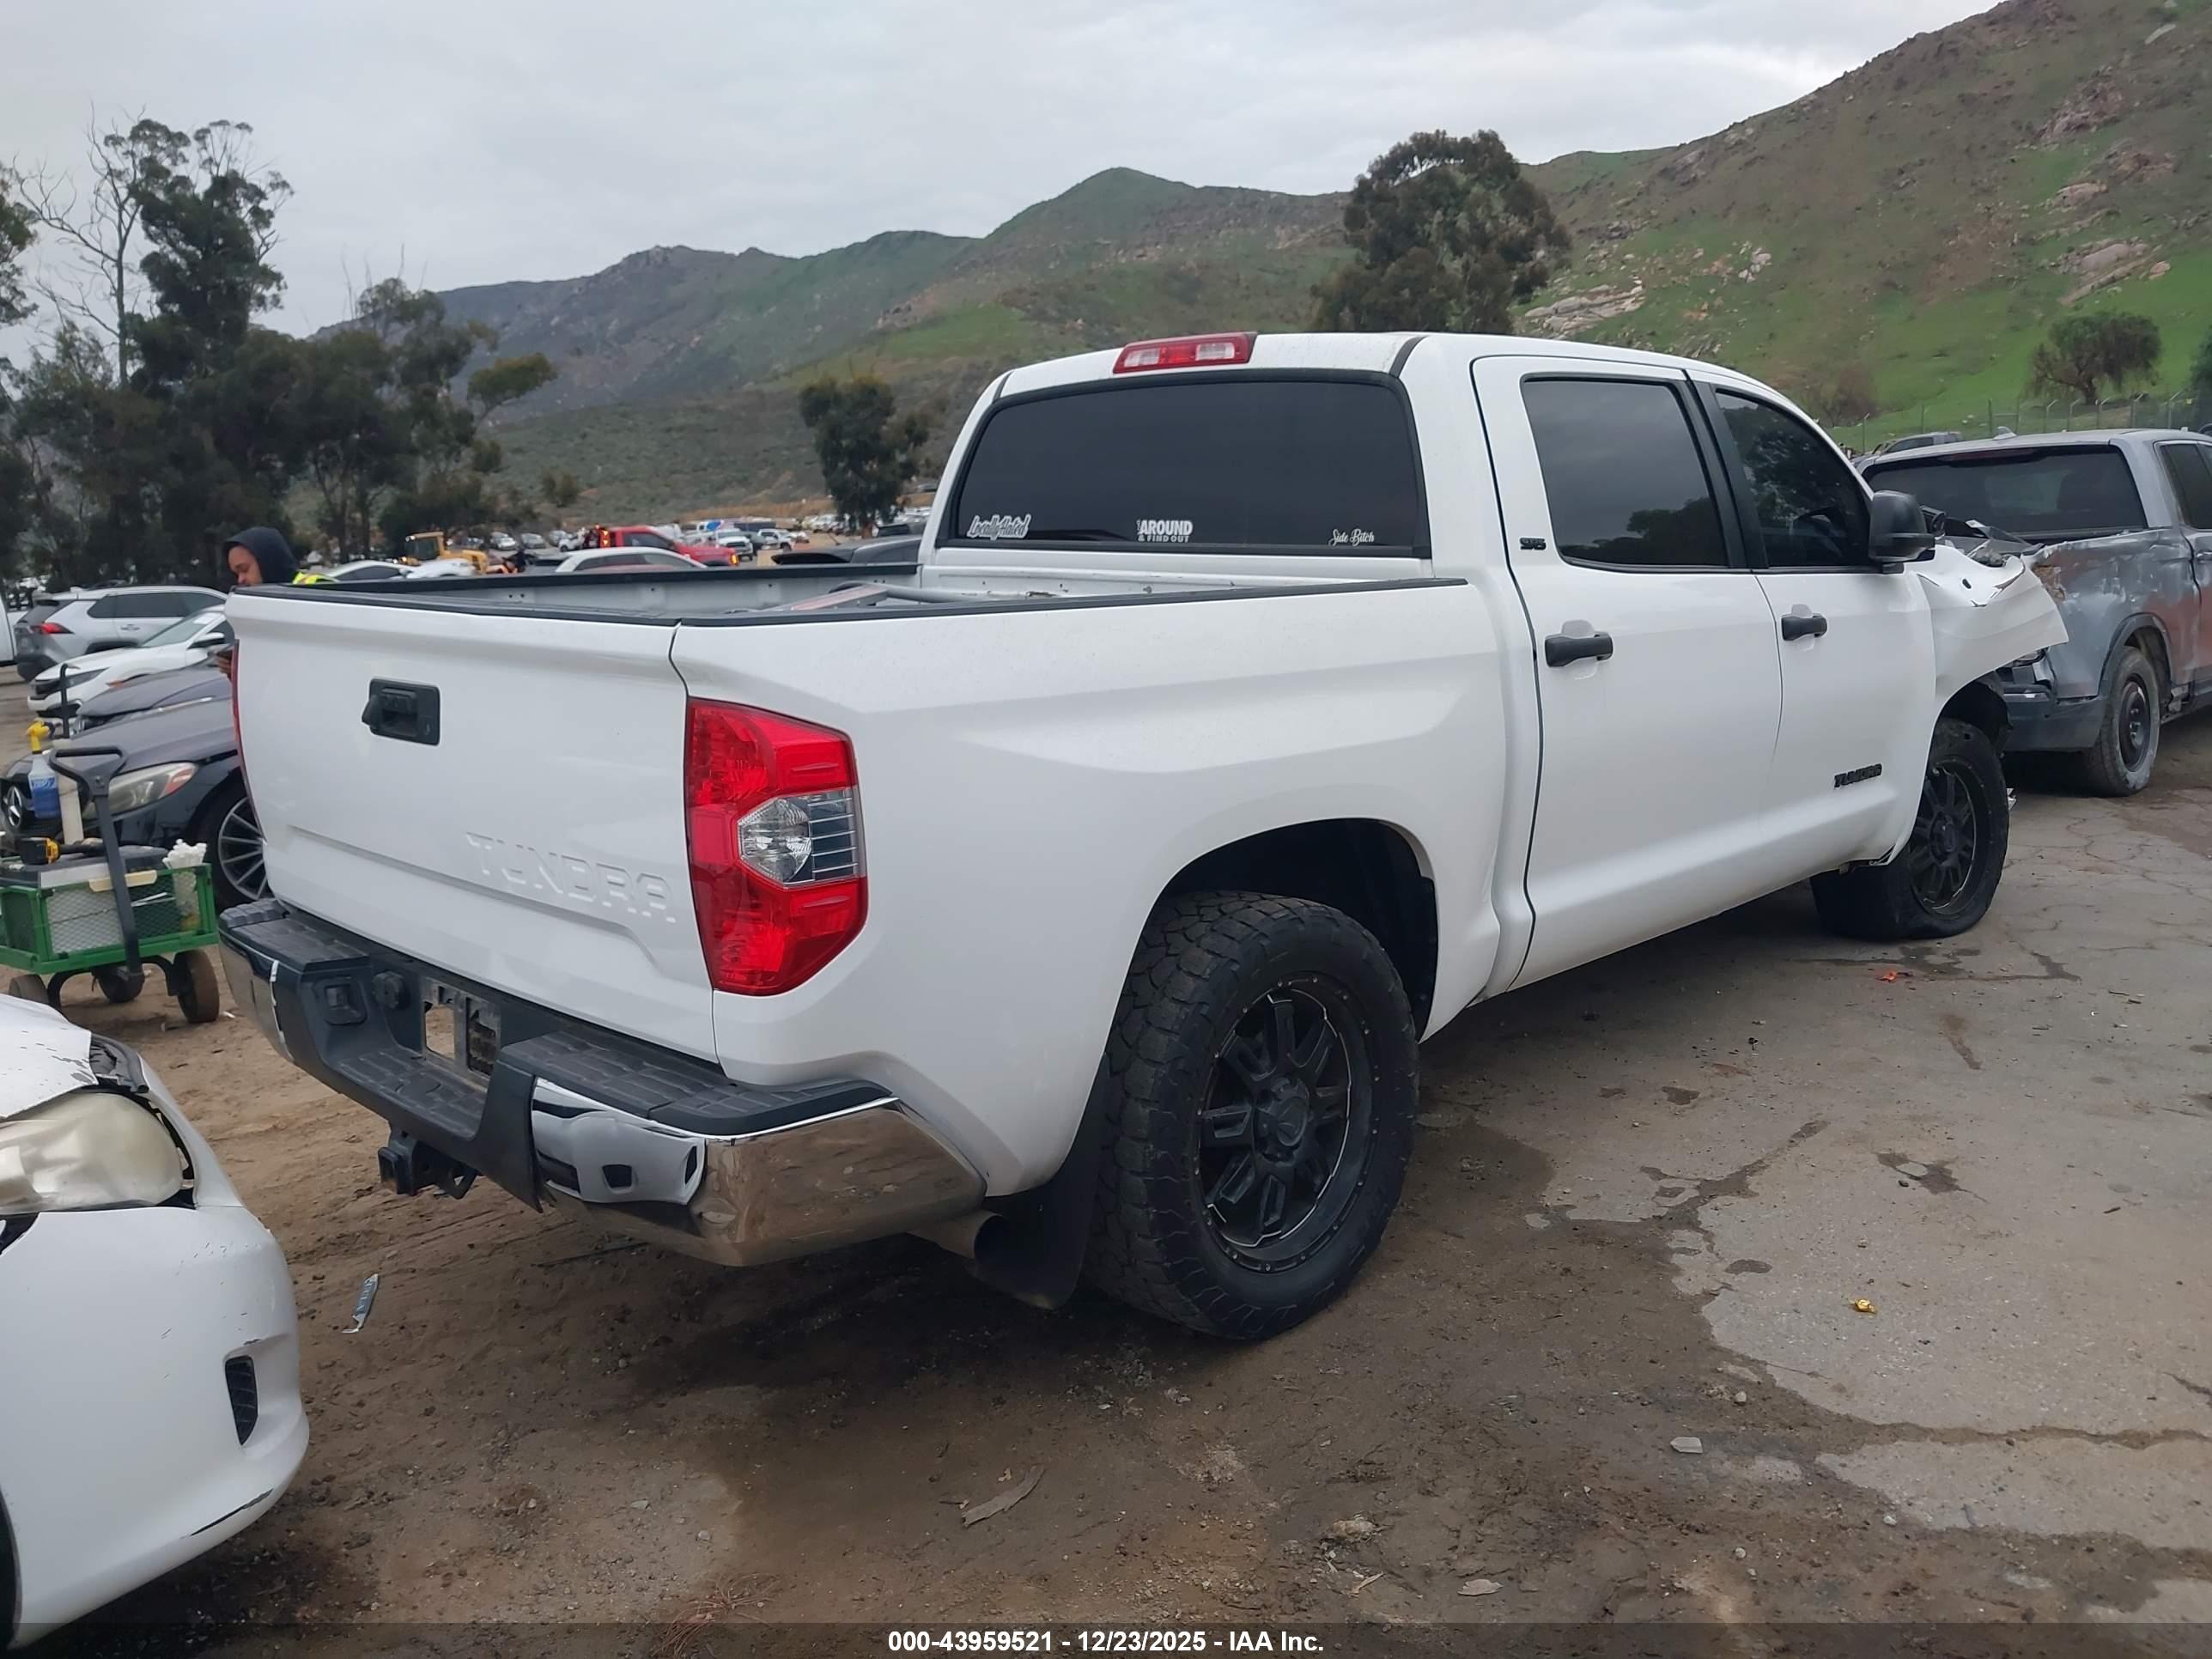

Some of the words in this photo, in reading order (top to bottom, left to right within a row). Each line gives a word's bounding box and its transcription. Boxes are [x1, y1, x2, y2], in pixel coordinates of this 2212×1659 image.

[1137, 520, 1194, 535] AROUND
[1328, 528, 1349, 546] Side
[1349, 528, 1375, 547] Bitch
[1834, 763, 1882, 787] TUNDRA
[465, 831, 677, 923] TUNDRA
